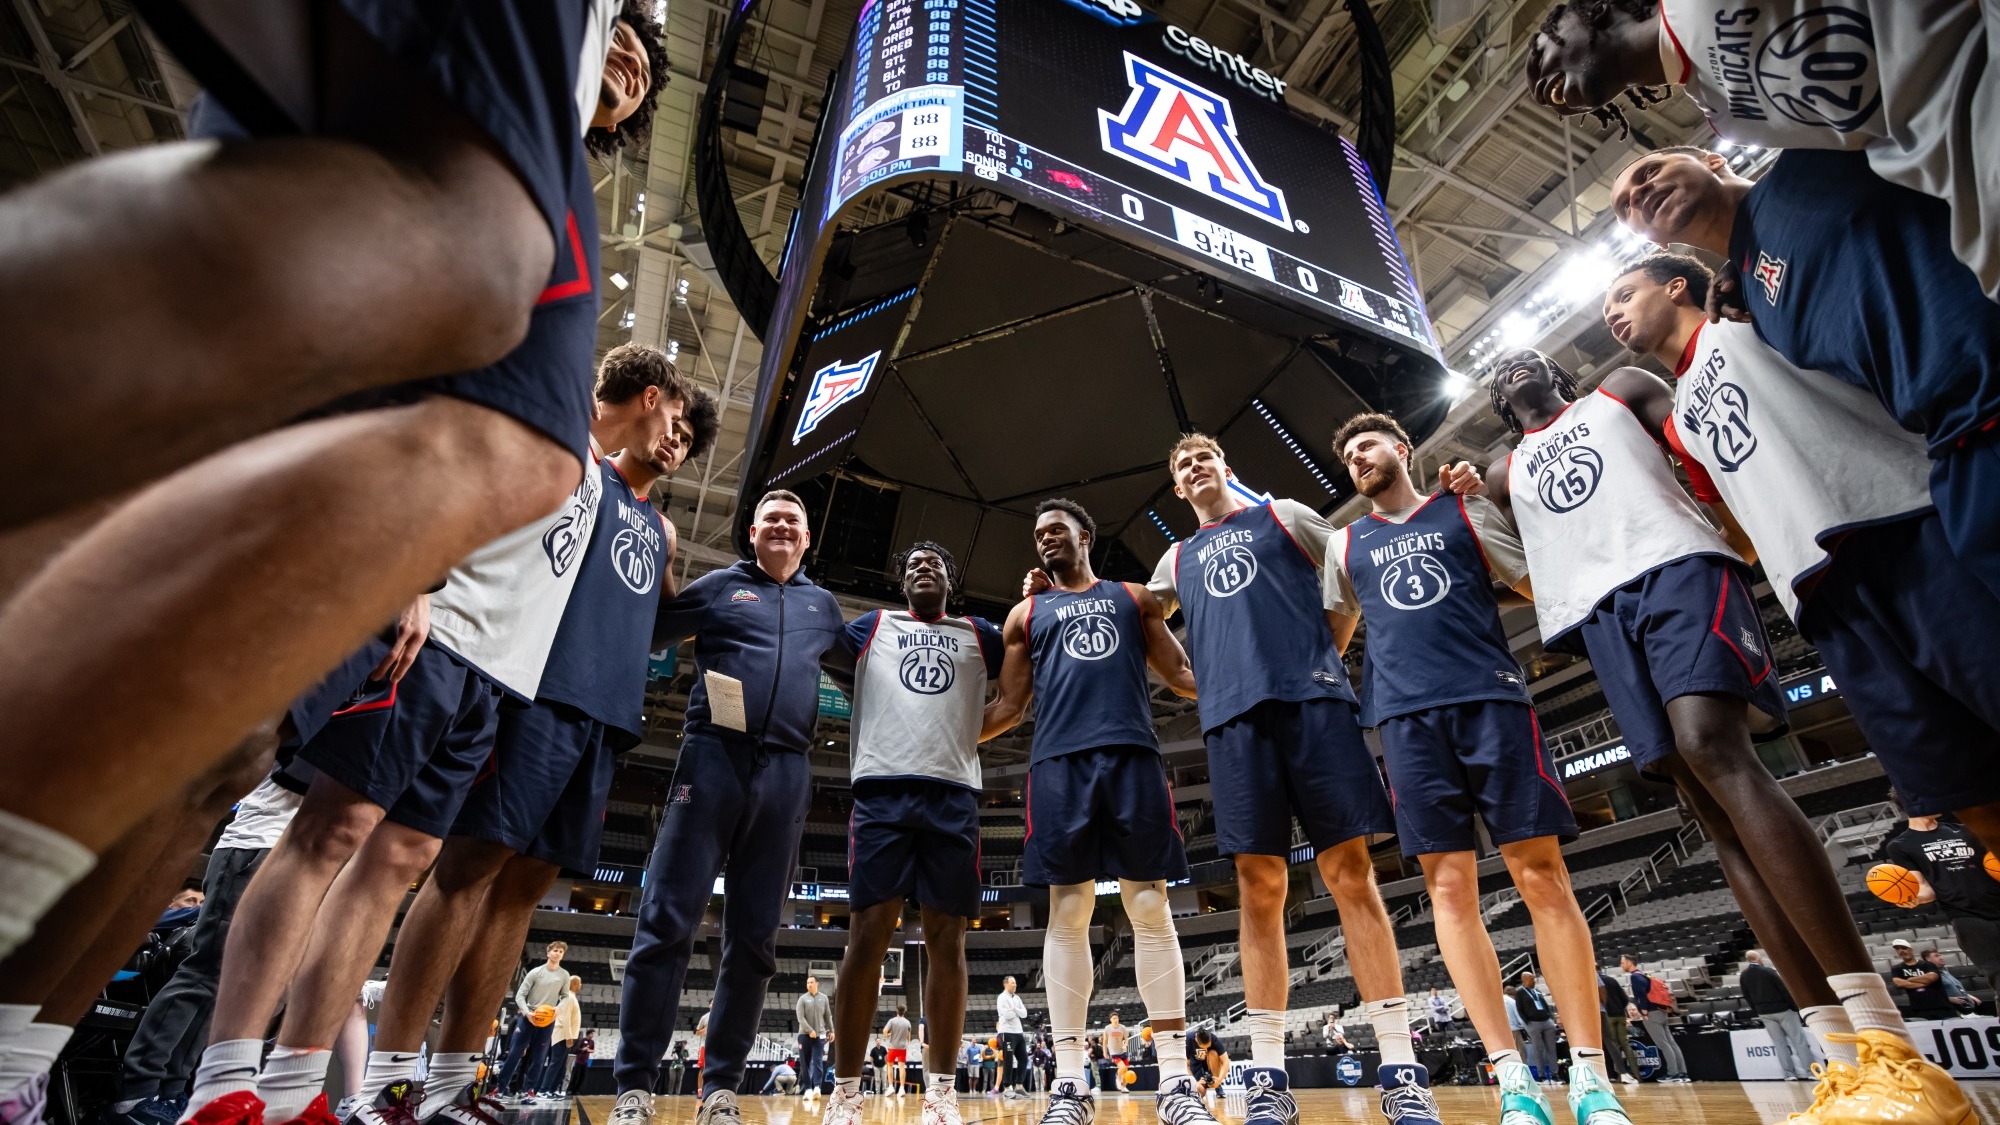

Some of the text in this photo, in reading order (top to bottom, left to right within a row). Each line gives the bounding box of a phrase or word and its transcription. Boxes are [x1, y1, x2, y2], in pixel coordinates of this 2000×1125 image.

[882, 26, 914, 47] OREB
[929, 21, 951, 32] 88
[888, 16, 911, 33] AST
[930, 10, 951, 20] 88
[881, 38, 913, 60] DREB
[928, 33, 950, 44] 88
[884, 53, 906, 70] STL
[927, 46, 950, 56] 88
[882, 64, 906, 83] BLK
[926, 59, 949, 69] 88
[1165, 24, 1288, 96] center
[1707, 46, 1725, 88] ARIZONA
[1715, 7, 1768, 121] WILDCATS
[885, 80, 901, 94] TO
[926, 72, 949, 82] 88
[1801, 51, 1868, 111] 20
[875, 98, 946, 121] BASKETBALL
[913, 113, 939, 126] 88
[912, 135, 937, 149] 88
[984, 130, 1006, 147] TOL
[890, 160, 912, 173] PM
[965, 151, 1007, 174] BONUS
[986, 144, 1033, 170] FLS 10
[1121, 193, 1144, 222] 0
[1194, 230, 1257, 272] 9:42
[1296, 265, 1319, 294] 0
[1537, 431, 1564, 449] ARIZONA
[1722, 410, 1752, 458] 21
[1526, 423, 1591, 479] WILDCATS
[1557, 467, 1587, 503] 15
[617, 499, 660, 553] WILDCATS
[1210, 529, 1233, 541] ARIZONA
[1389, 531, 1419, 544] ARIZONA
[1197, 529, 1253, 565] WILDCATS
[1369, 532, 1445, 568] WILDCATS
[626, 551, 642, 585] 10
[1218, 562, 1241, 591] 13
[1407, 574, 1425, 601] 3
[1055, 599, 1116, 622] WILDCATS
[897, 634, 959, 653] WILDCATS
[1078, 631, 1106, 654] 30
[914, 666, 941, 689] 42
[1786, 684, 1813, 702] VS
[1565, 745, 1632, 778] ARKANS
[1903, 968, 1925, 977] Nah
[1746, 1045, 1777, 1057] HOST
